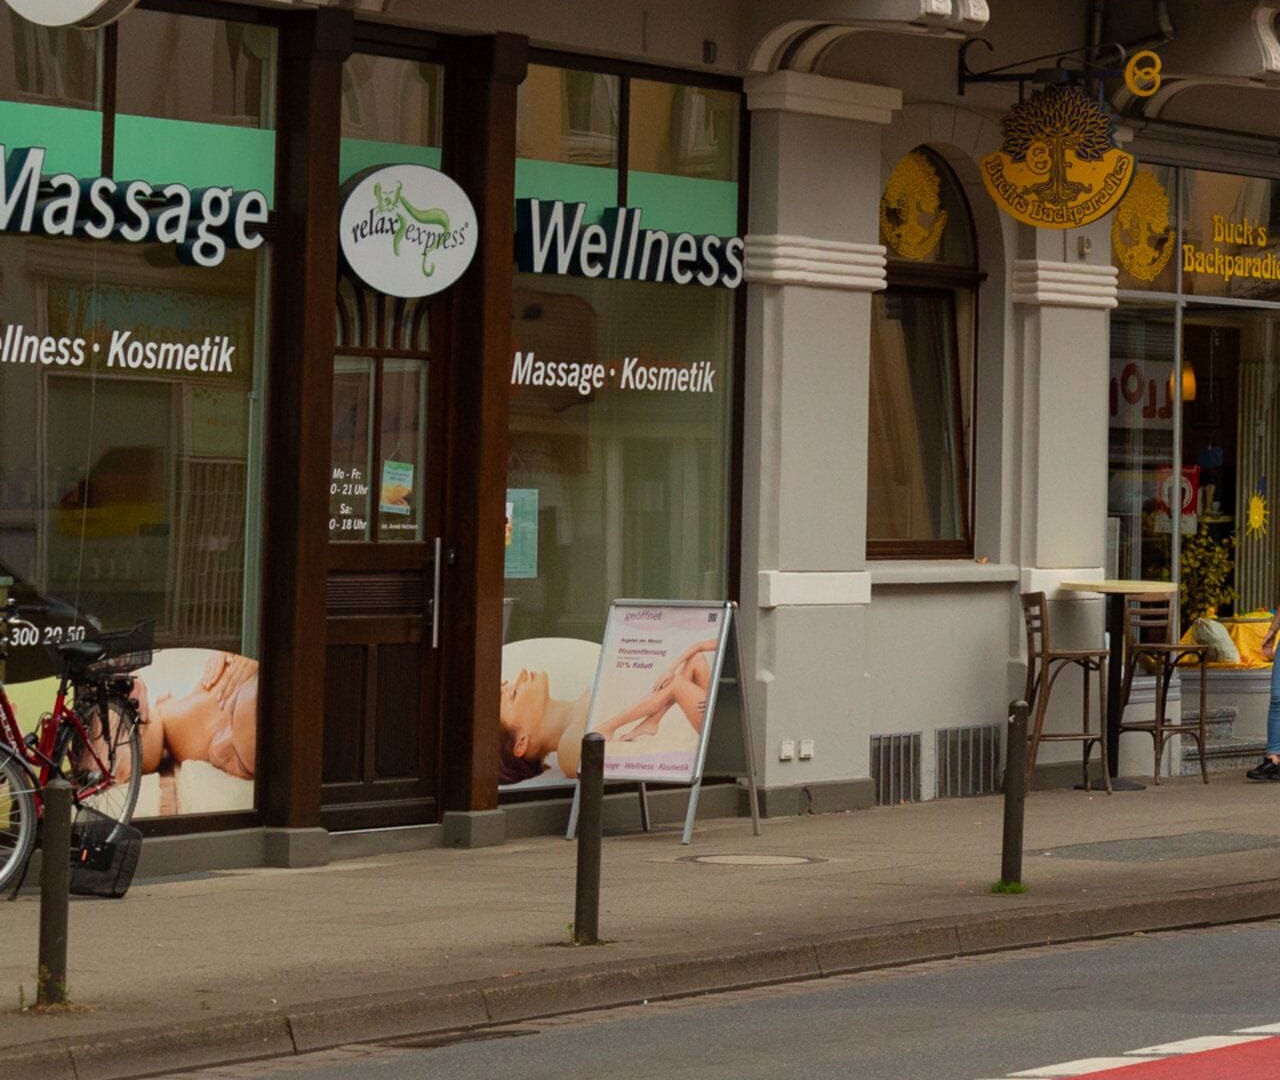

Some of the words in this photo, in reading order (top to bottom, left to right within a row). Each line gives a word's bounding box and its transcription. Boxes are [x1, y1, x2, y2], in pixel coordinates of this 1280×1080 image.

[0, 144, 268, 267] Massage
[352, 208, 398, 243] relax
[1212, 215, 1267, 247] Buck's
[530, 198, 745, 289] Wellness
[107, 330, 235, 372] Kosmetik
[511, 351, 605, 395] Massage
[620, 357, 715, 392] Kosmetik
[332, 468, 345, 479] Mo
[342, 484, 352, 495] 21
[353, 484, 368, 495] Uhr
[342, 519, 351, 530] 18
[353, 519, 367, 530] Uhr
[10, 627, 39, 646] 300
